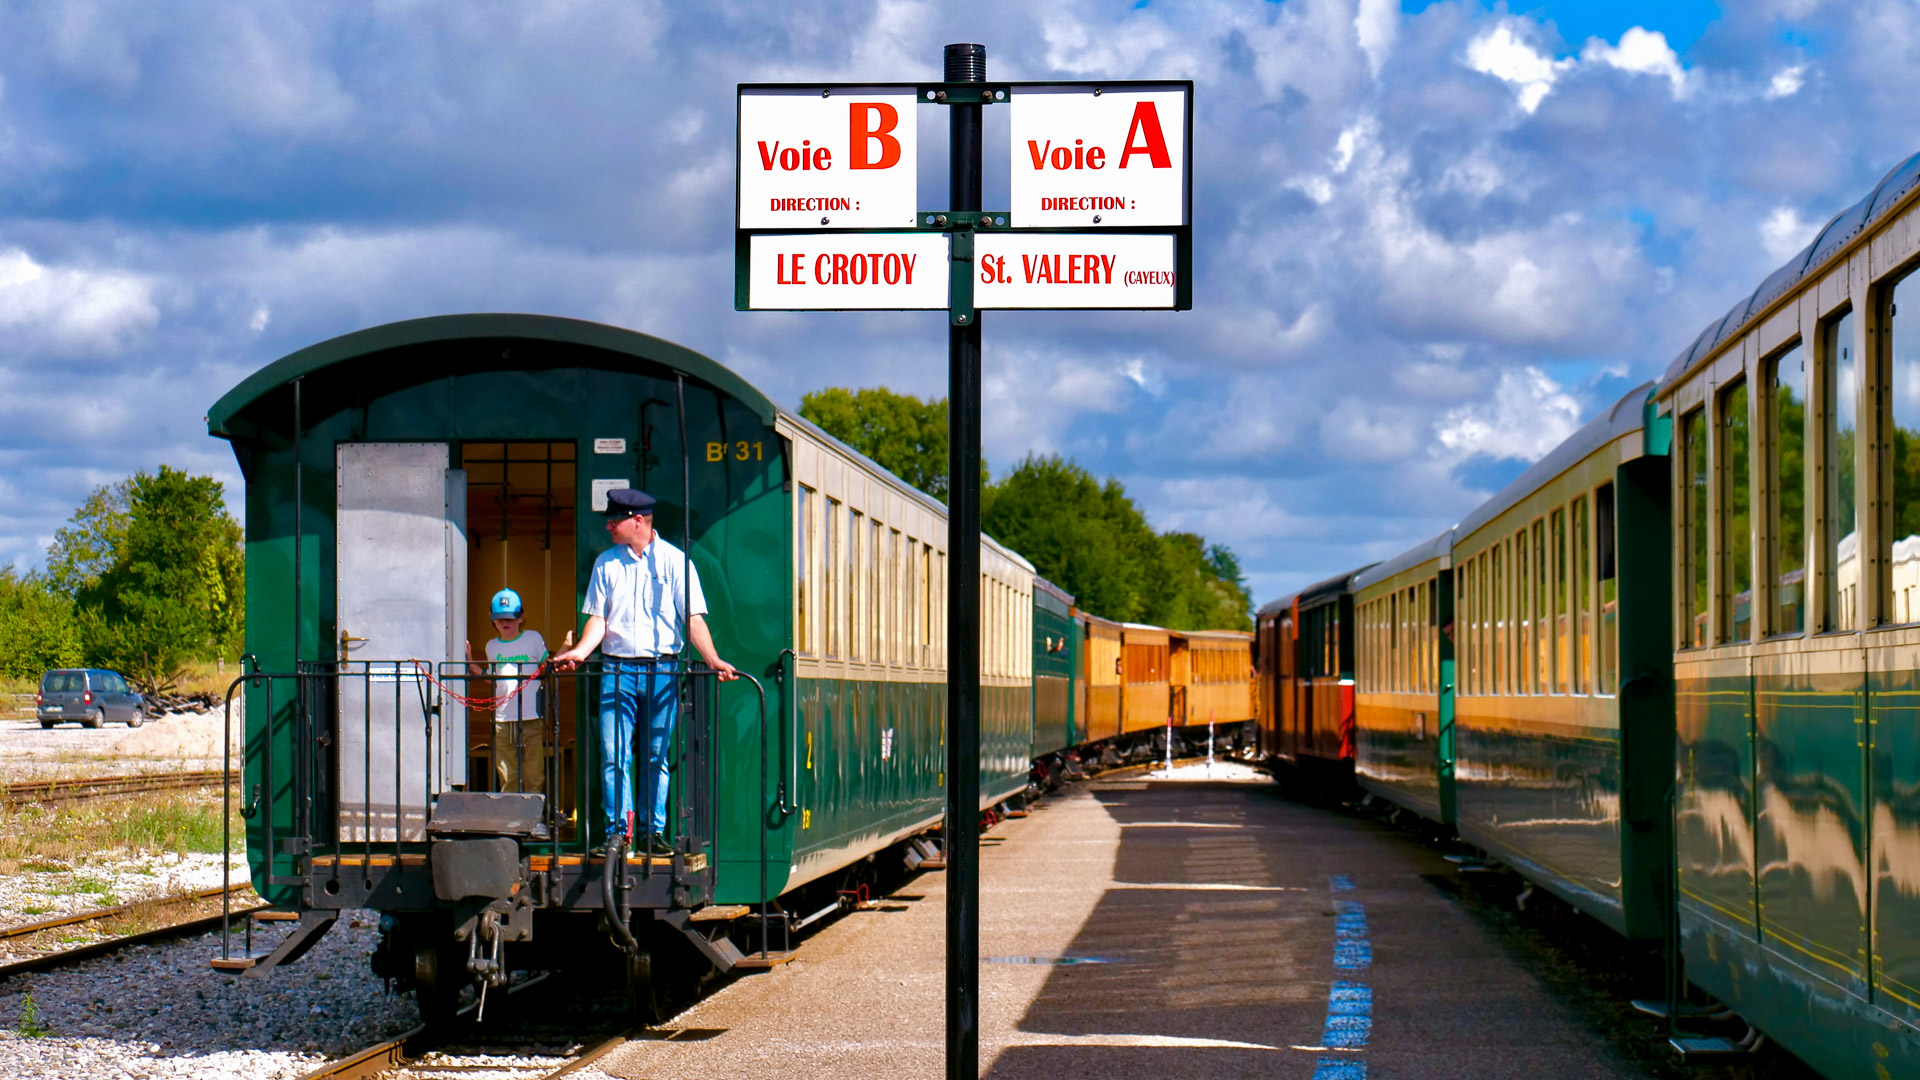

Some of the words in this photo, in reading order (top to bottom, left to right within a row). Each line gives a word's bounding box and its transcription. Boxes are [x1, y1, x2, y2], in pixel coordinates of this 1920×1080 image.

[757, 140, 832, 171] Voie
[849, 102, 902, 170] B
[1027, 138, 1106, 170] Voie
[1118, 101, 1173, 169] A
[770, 198, 851, 212] DIRECTION
[1041, 196, 1126, 211] DIRECTION
[777, 253, 806, 285] LE
[814, 253, 917, 285] CROTOY
[980, 253, 1013, 285] St.
[1022, 254, 1116, 285] VALERY
[1124, 270, 1176, 287] (CAYEUX)
[735, 441, 763, 461] 31
